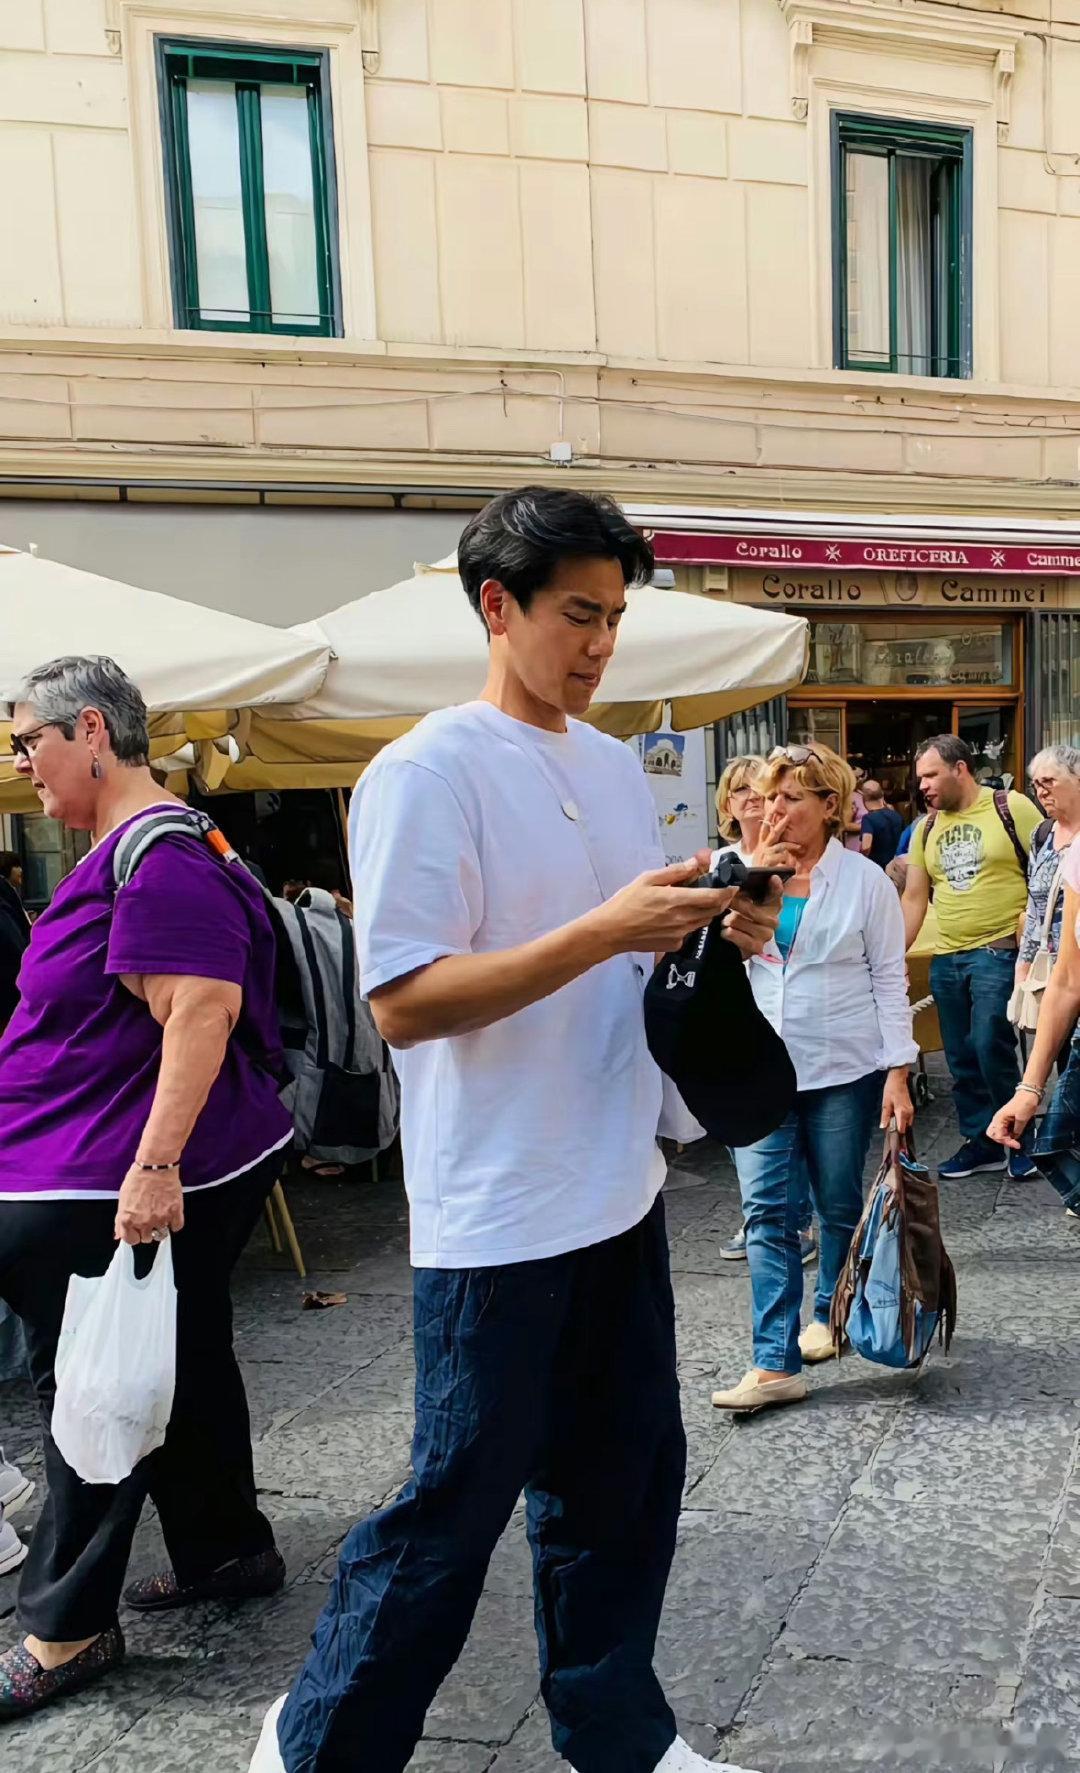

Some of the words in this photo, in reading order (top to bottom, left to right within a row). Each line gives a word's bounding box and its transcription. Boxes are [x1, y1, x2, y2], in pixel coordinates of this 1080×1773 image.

[736, 542, 802, 559] Corallo
[863, 547, 970, 564] OREFICERIA
[762, 574, 861, 600] Corallo
[941, 579, 1046, 603] Cammei
